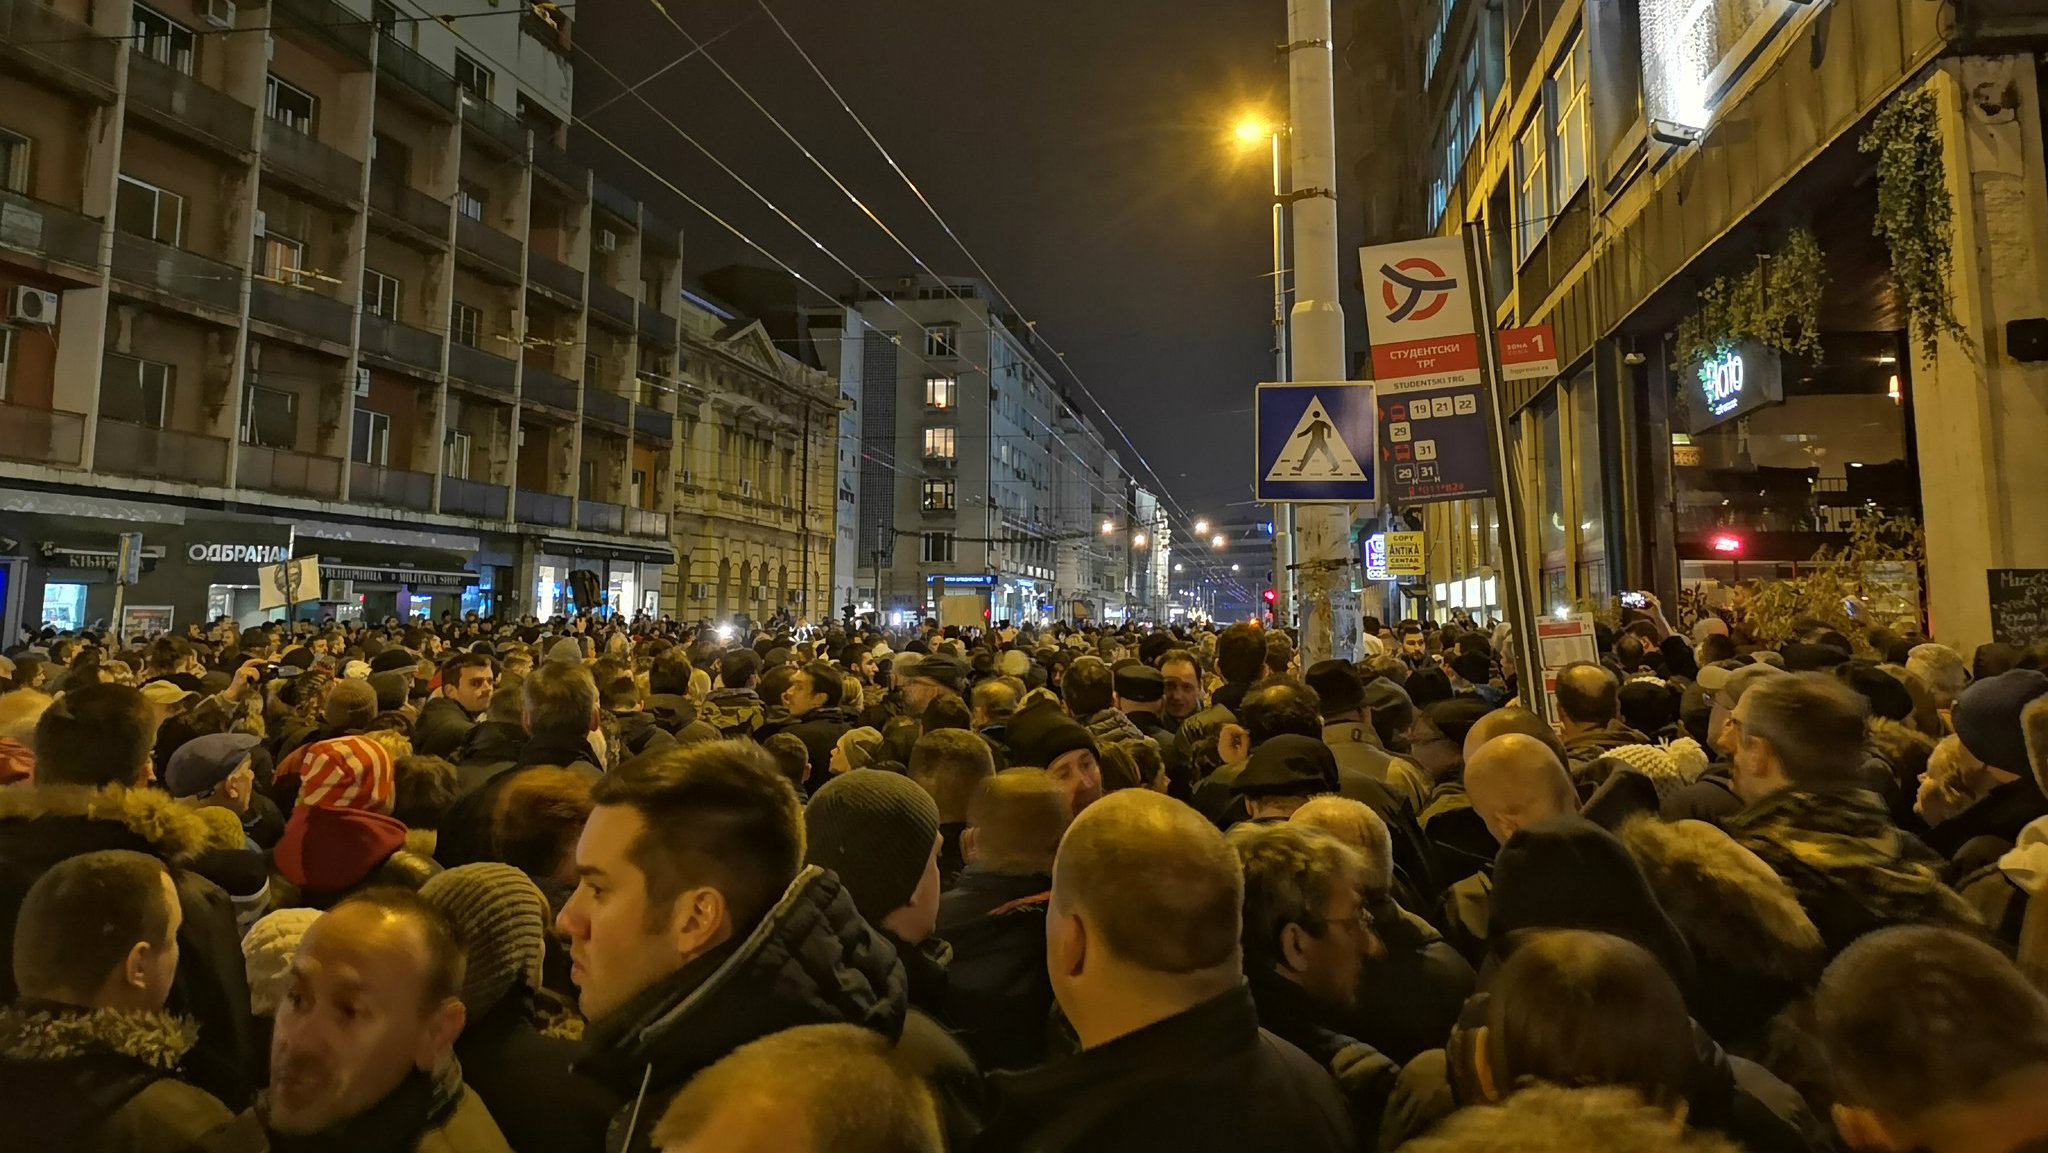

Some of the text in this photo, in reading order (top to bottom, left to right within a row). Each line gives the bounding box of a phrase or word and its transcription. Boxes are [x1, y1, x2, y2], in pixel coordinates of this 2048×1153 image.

[1532, 334, 1544, 352] 1
[1390, 344, 1459, 359] СТУДЕНТСКИ
[1417, 359, 1435, 368] ТРГ
[1393, 375, 1464, 390] STUDENTSKI TRG
[1414, 400, 1472, 413] 19 21 22
[1394, 427, 1406, 436] 29
[1419, 446, 1431, 455] 31
[1398, 468, 1412, 478] 29
[1421, 466, 1433, 476] 31
[189, 544, 281, 562] ОДБРАНА
[1390, 542, 1420, 555] ANTIKA
[440, 576, 461, 585] SHOP
